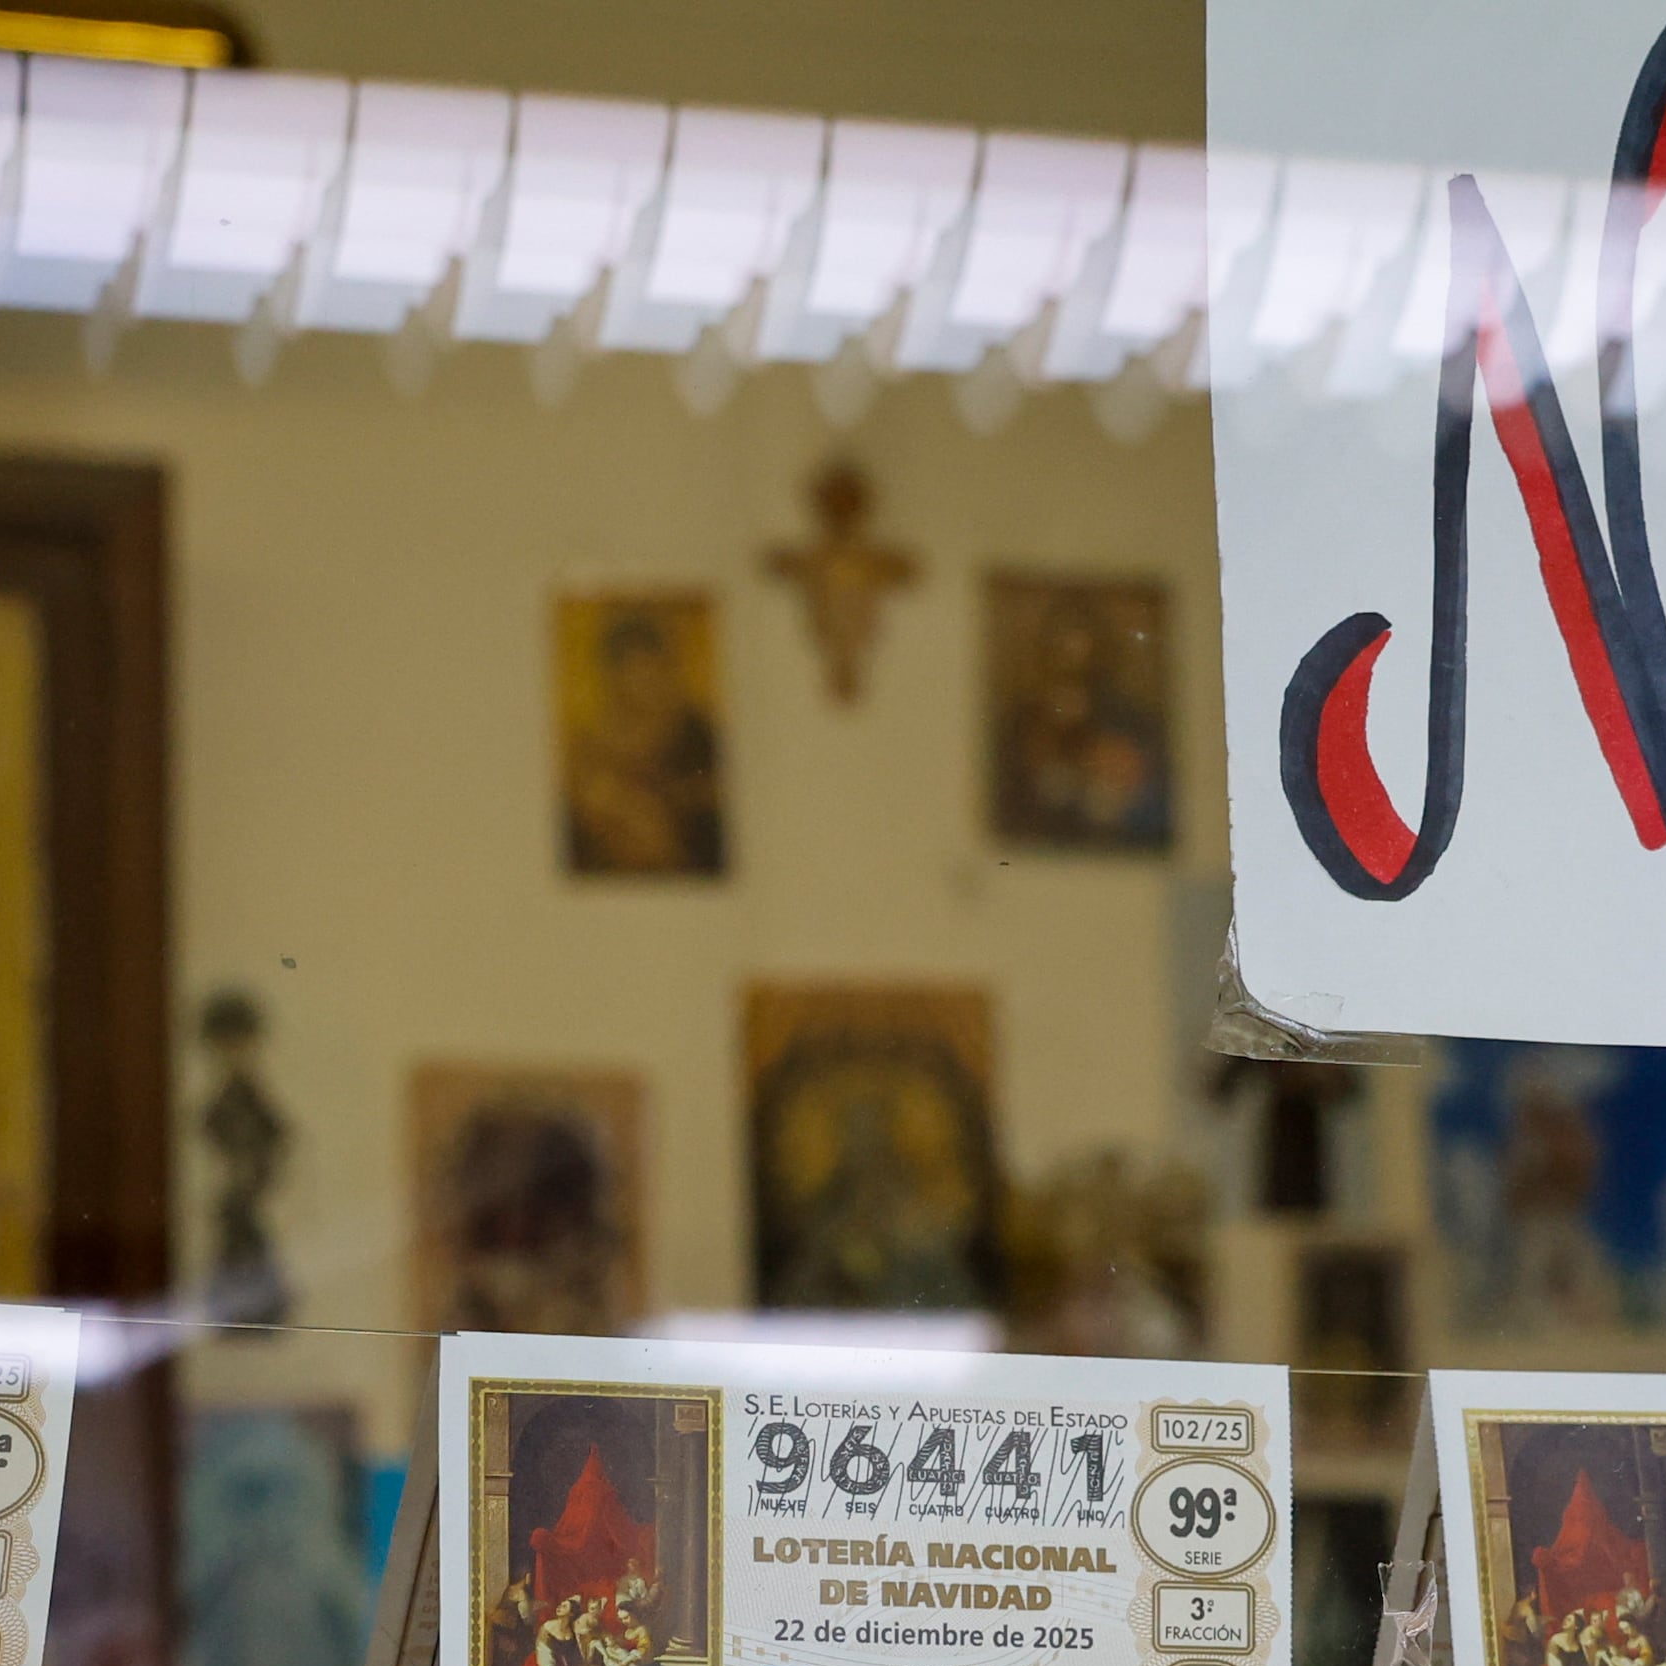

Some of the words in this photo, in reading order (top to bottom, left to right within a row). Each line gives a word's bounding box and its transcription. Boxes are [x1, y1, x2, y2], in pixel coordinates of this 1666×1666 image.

[1163, 1418, 1243, 1442] 102/25
[755, 1421, 1105, 1502] 96441
[752, 1533, 915, 1568] LOTERÍA
[927, 1542, 1118, 1574] NACIONAL
[1184, 1550, 1222, 1566] SERIE
[819, 1578, 869, 1606] DE
[880, 1581, 1053, 1612] NAVIDAD
[774, 1618, 806, 1642] 22
[813, 1619, 847, 1644] de
[855, 1620, 985, 1647] diciembre
[992, 1623, 1025, 1649] de
[1032, 1626, 1094, 1651] 2025
[1165, 1623, 1242, 1642] FRACCIÓN
